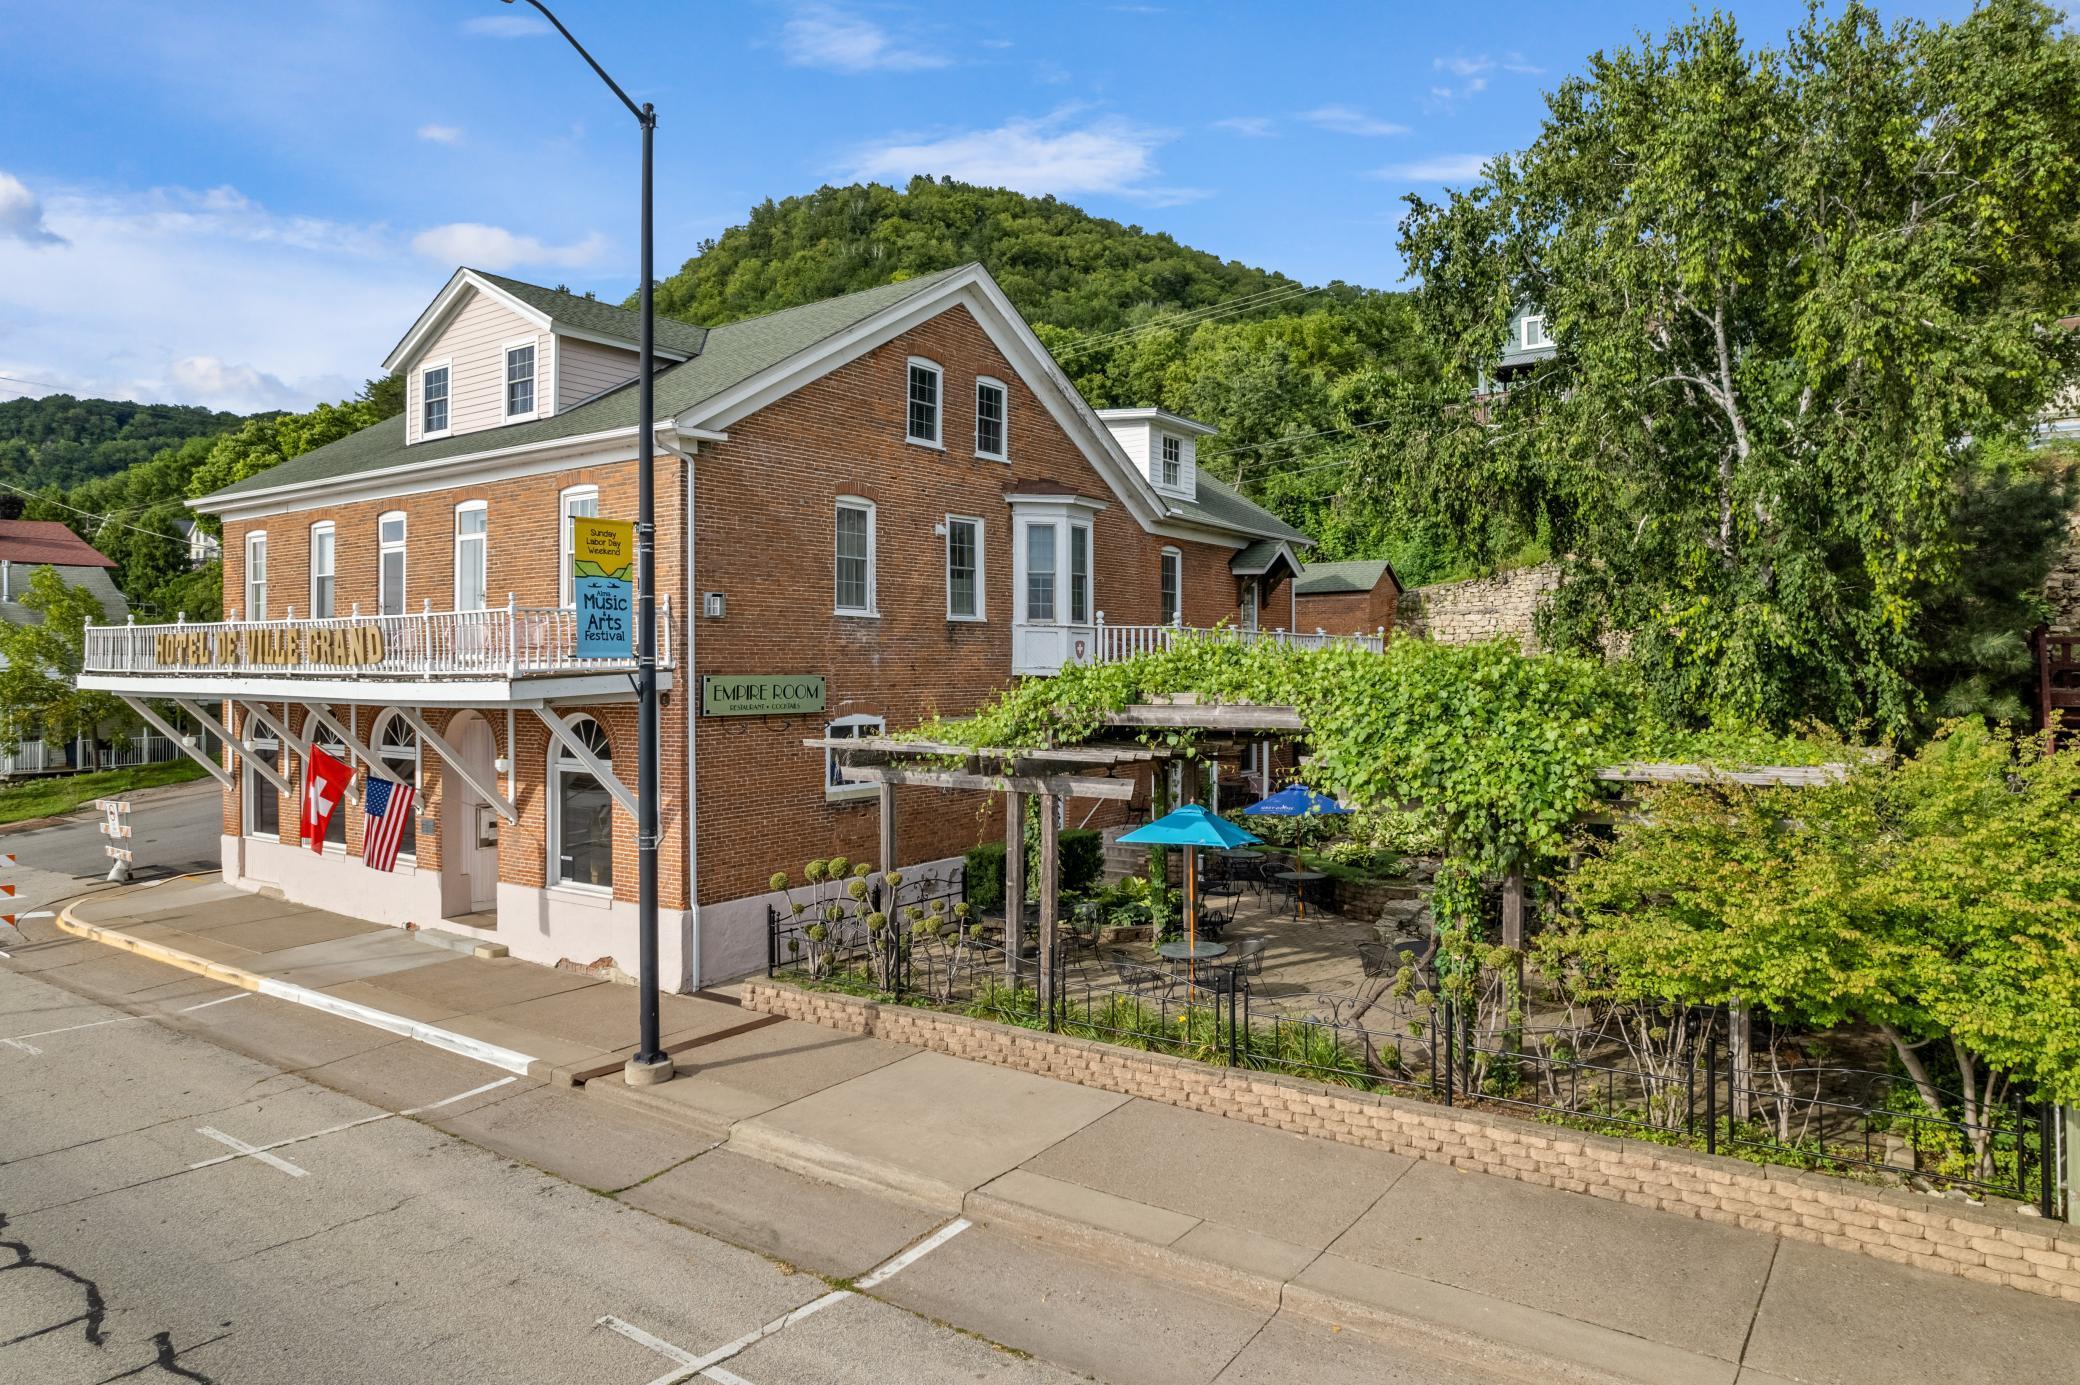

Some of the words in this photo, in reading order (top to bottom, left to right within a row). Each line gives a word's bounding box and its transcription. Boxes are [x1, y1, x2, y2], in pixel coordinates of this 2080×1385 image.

[590, 528, 616, 539] Sunday
[586, 537, 606, 546] Labor
[608, 539, 621, 549] Day
[588, 546, 620, 556] Weekend
[584, 593, 628, 611] Music
[588, 613, 622, 630] Arts
[584, 631, 625, 641] Festival
[155, 632, 208, 665] HOTEL
[215, 631, 240, 664] DE
[246, 627, 301, 665] VILLE
[307, 625, 384, 665] GRAND
[713, 685, 768, 701] EMPIRE
[772, 684, 818, 699] ROOM
[729, 703, 765, 711] RESTAURANT
[771, 701, 801, 710] COCKTAILS
